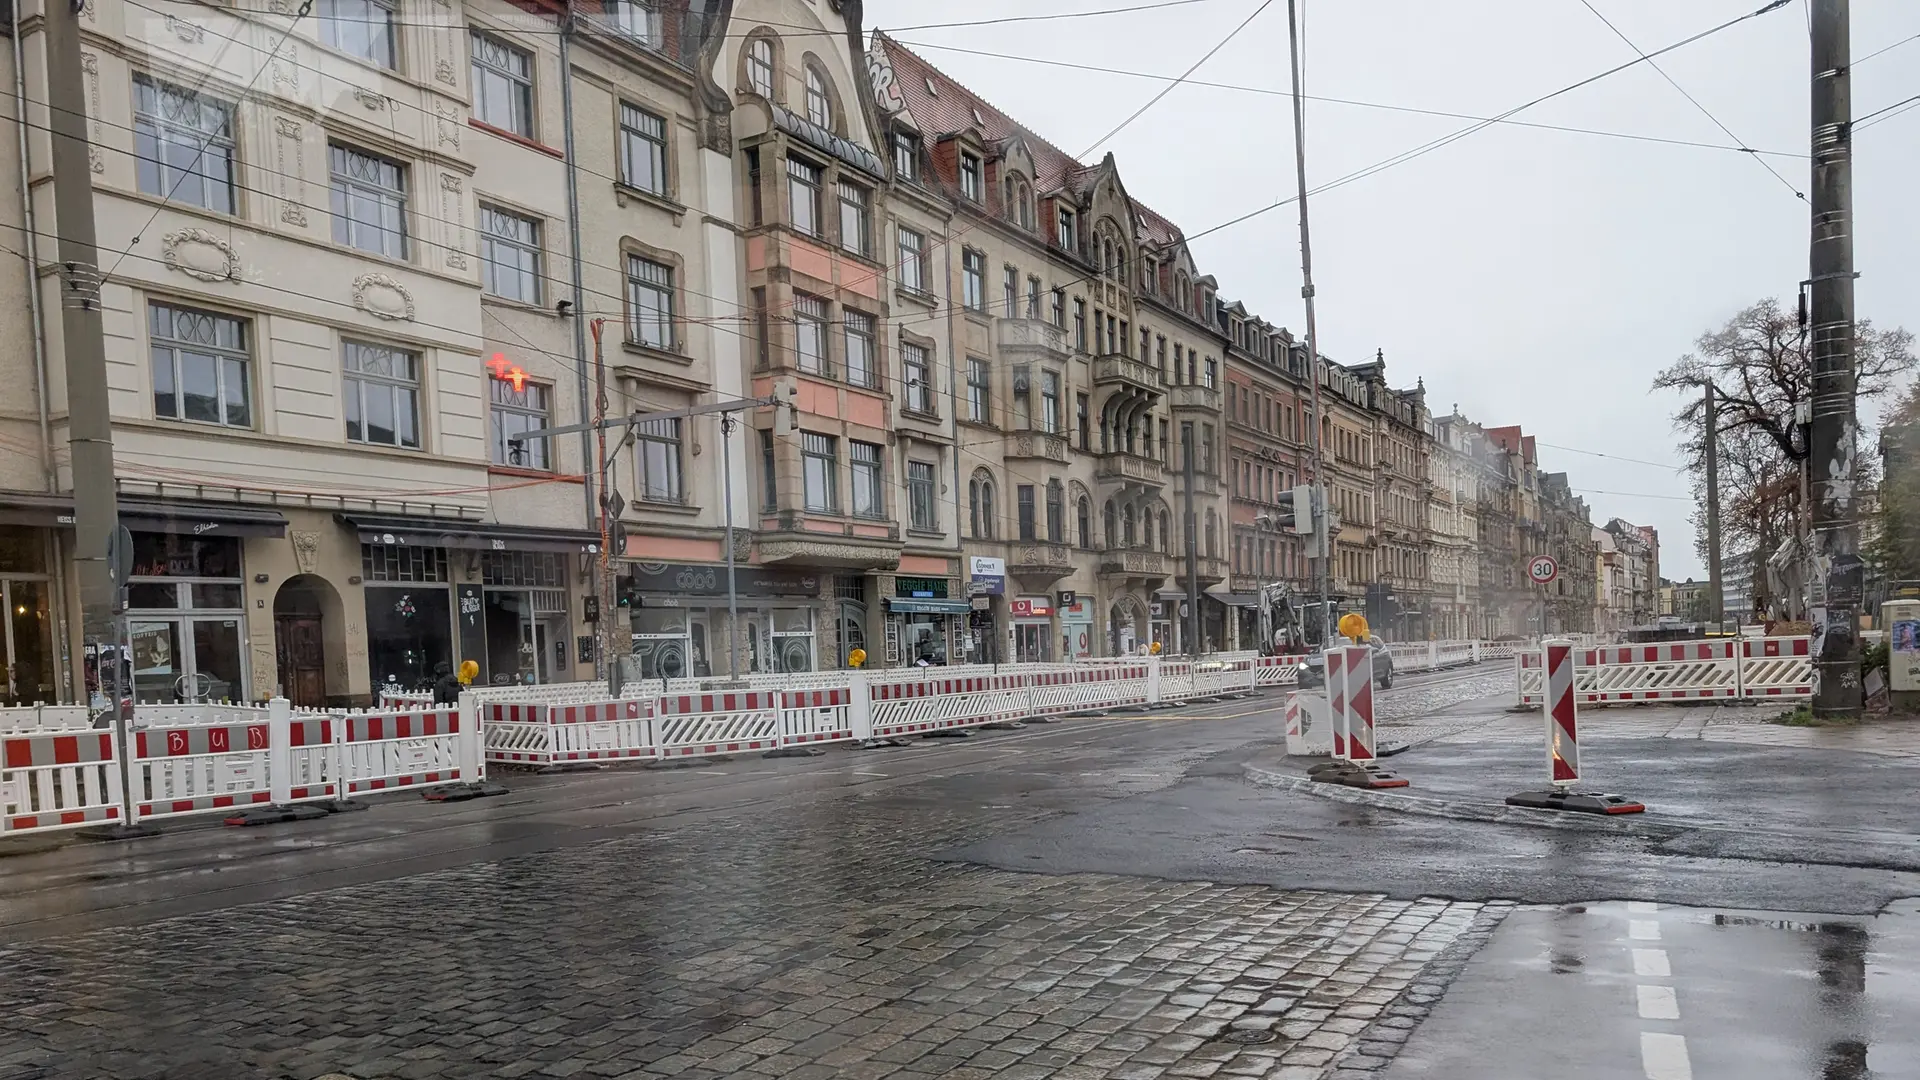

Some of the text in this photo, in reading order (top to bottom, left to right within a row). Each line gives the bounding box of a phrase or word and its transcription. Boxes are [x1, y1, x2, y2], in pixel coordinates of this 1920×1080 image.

[1534, 563, 1552, 576] 30
[897, 580, 948, 593] VEGGIE HAUS
